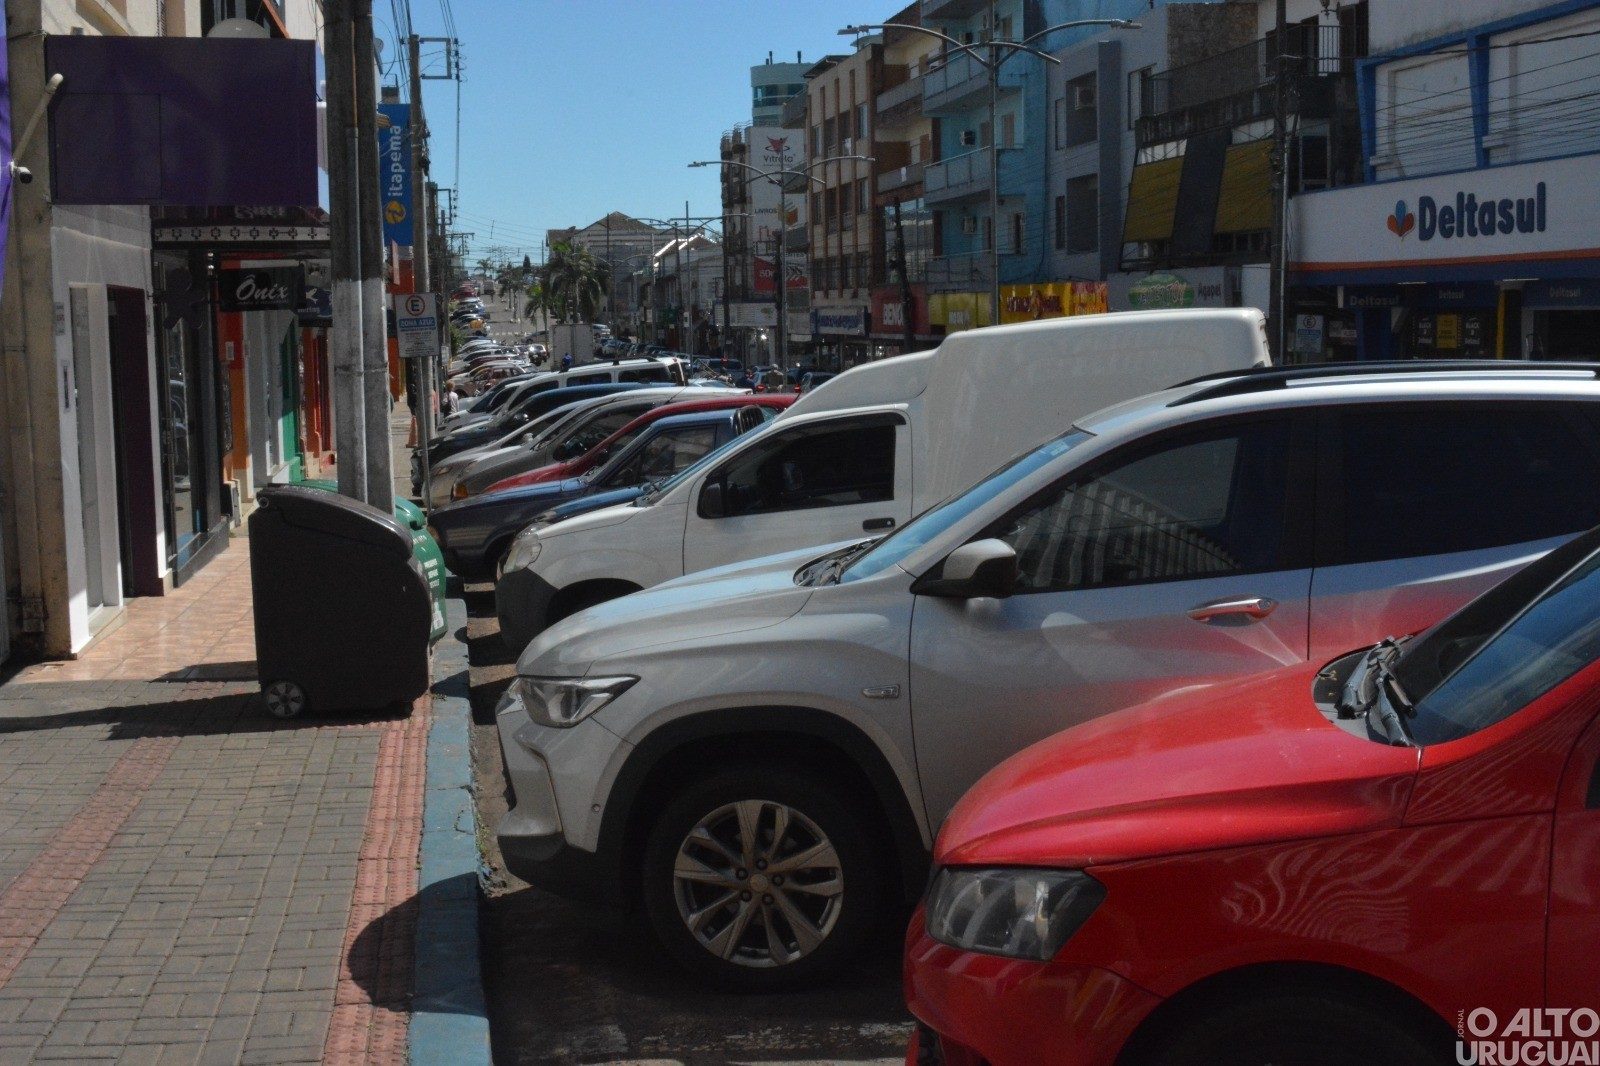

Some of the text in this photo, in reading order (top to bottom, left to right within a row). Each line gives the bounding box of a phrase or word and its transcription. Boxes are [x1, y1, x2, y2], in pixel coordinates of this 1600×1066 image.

[388, 125, 406, 197] itapema
[1419, 181, 1546, 241] Deltasul
[236, 274, 289, 301] Ônix
[411, 299, 420, 312] E
